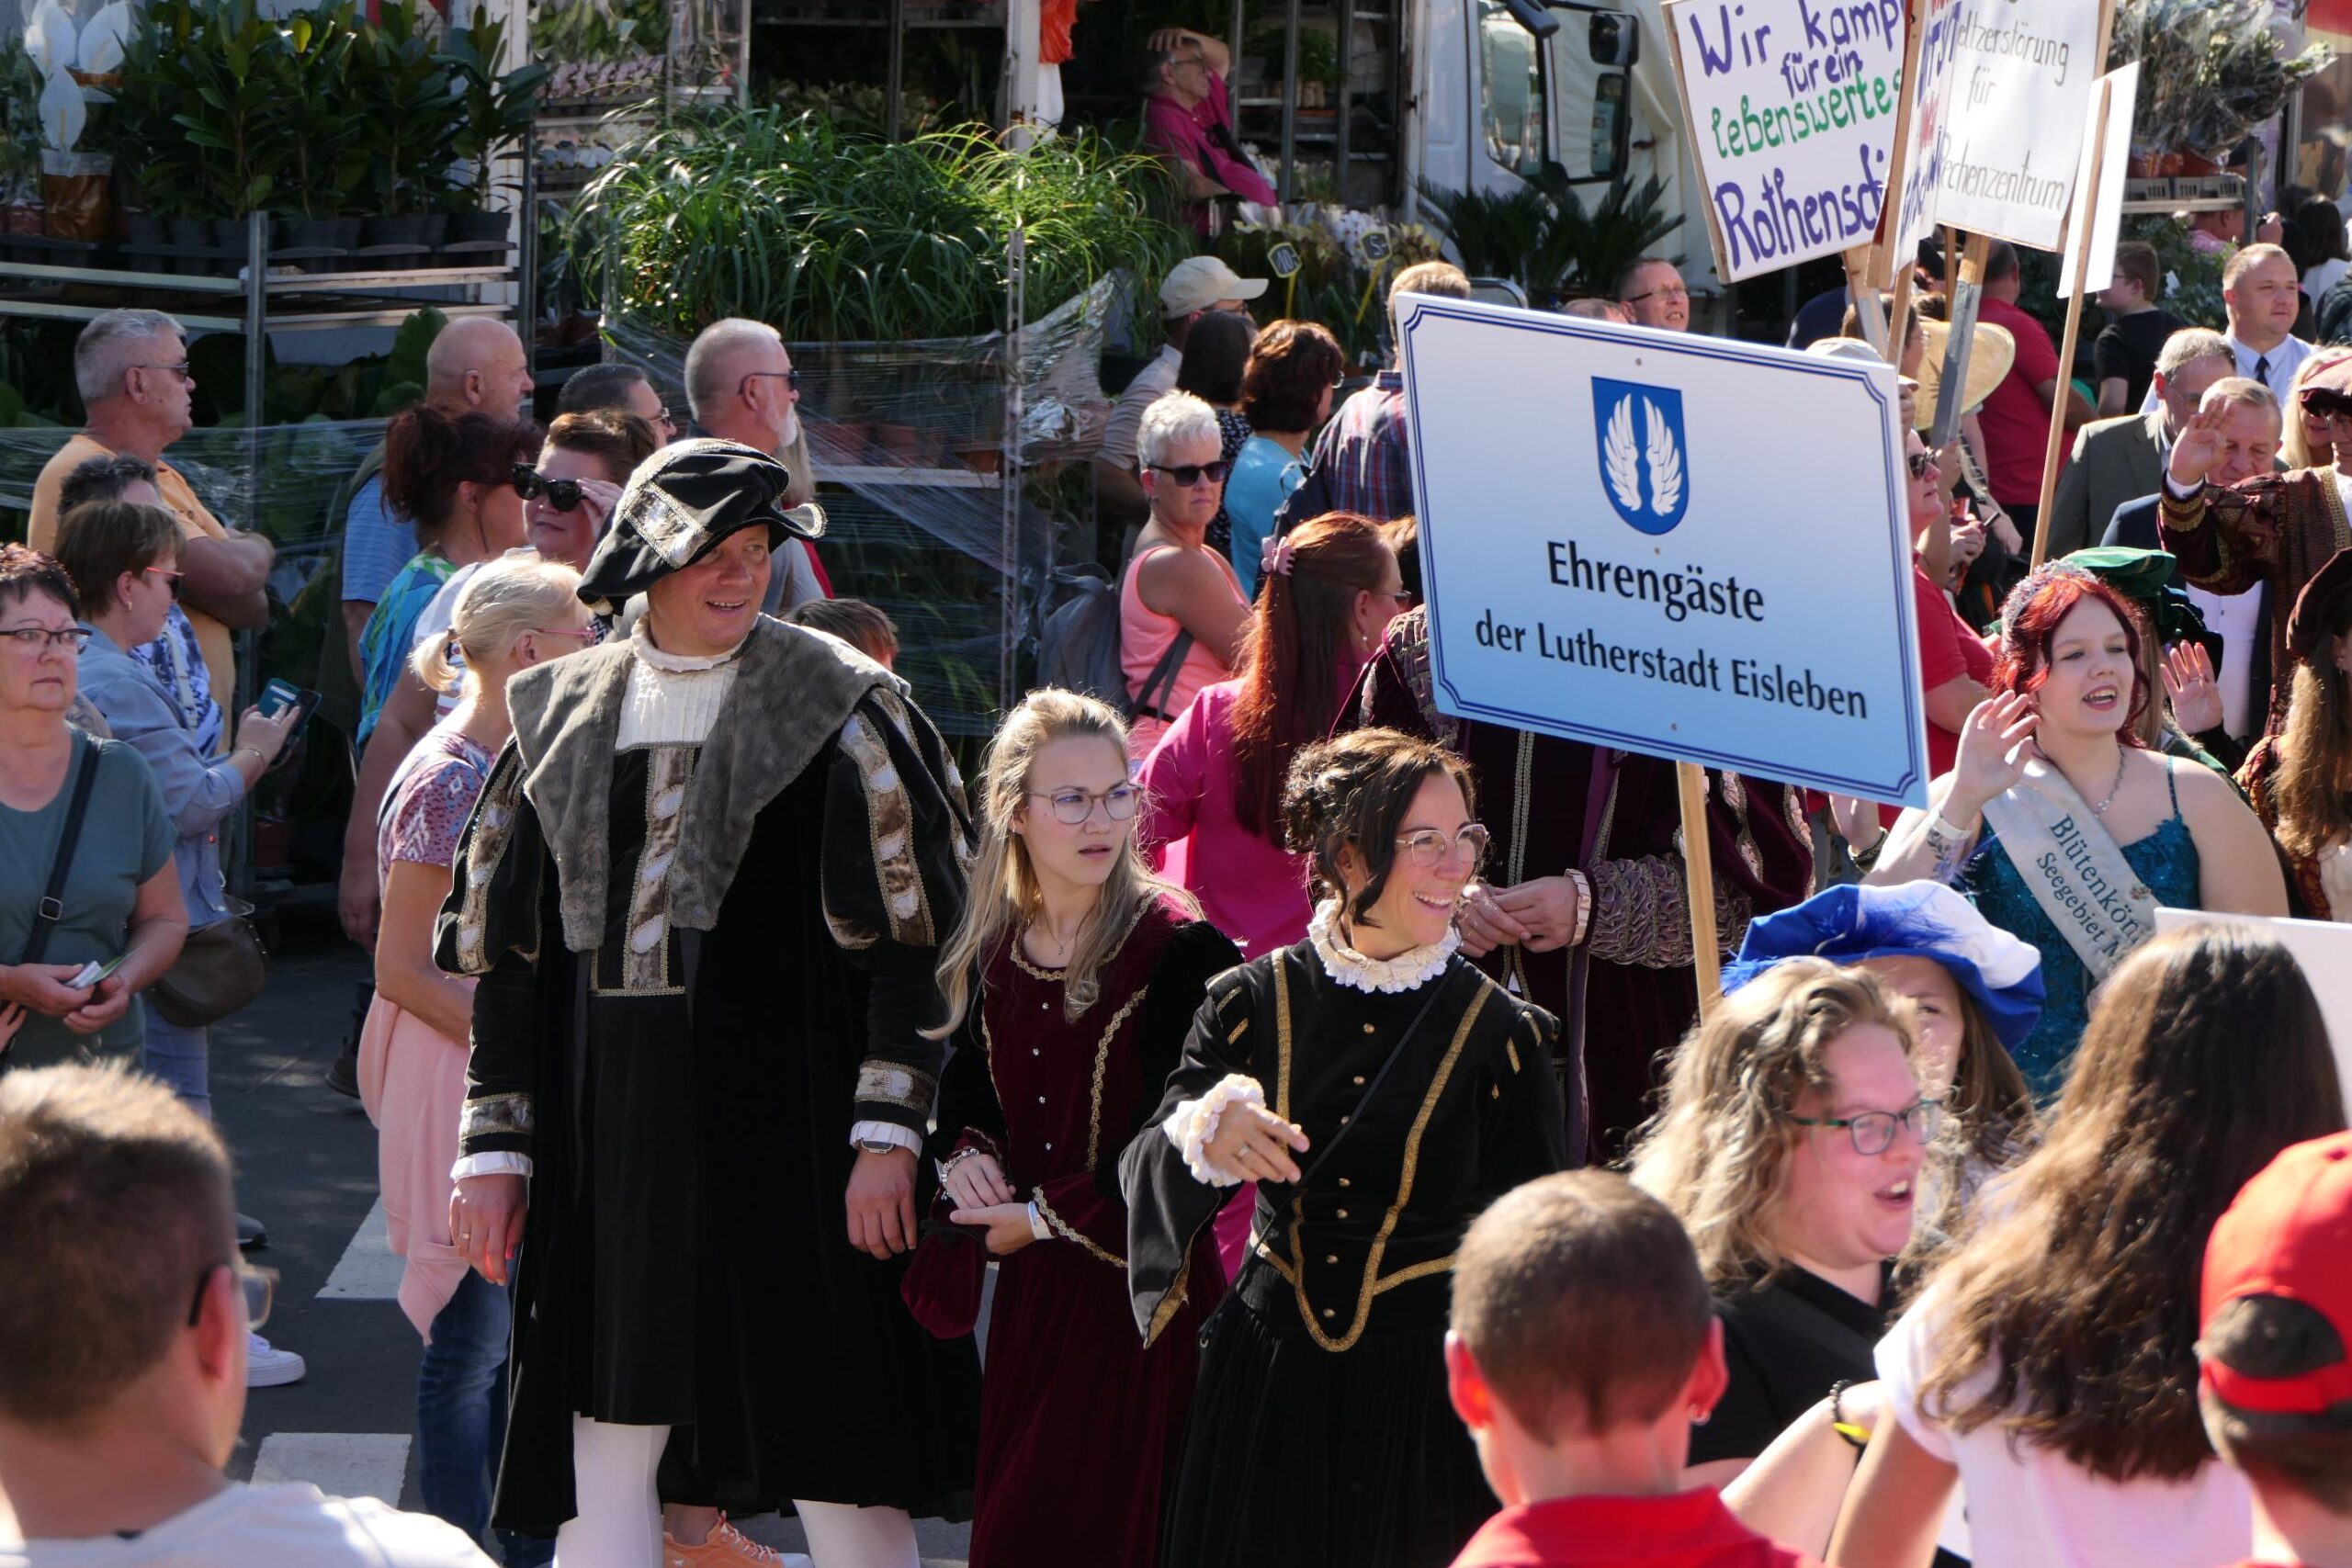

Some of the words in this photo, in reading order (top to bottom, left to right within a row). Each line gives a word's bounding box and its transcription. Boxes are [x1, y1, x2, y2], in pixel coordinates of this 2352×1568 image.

[1689, 4, 1771, 78] Wir
[1780, 51, 1819, 101] für
[1825, 45, 1863, 84] ein
[1957, 9, 2069, 87] eltzerstörung
[1968, 64, 1997, 113] für
[1714, 143, 1885, 271] Rothensch
[1547, 539, 1765, 623] Ehrengäste
[1475, 609, 1526, 652] der
[1537, 622, 1722, 693] Lutherstadt
[1731, 659, 1868, 720] Eisleben
[2036, 852, 2106, 942] Seegebiet
